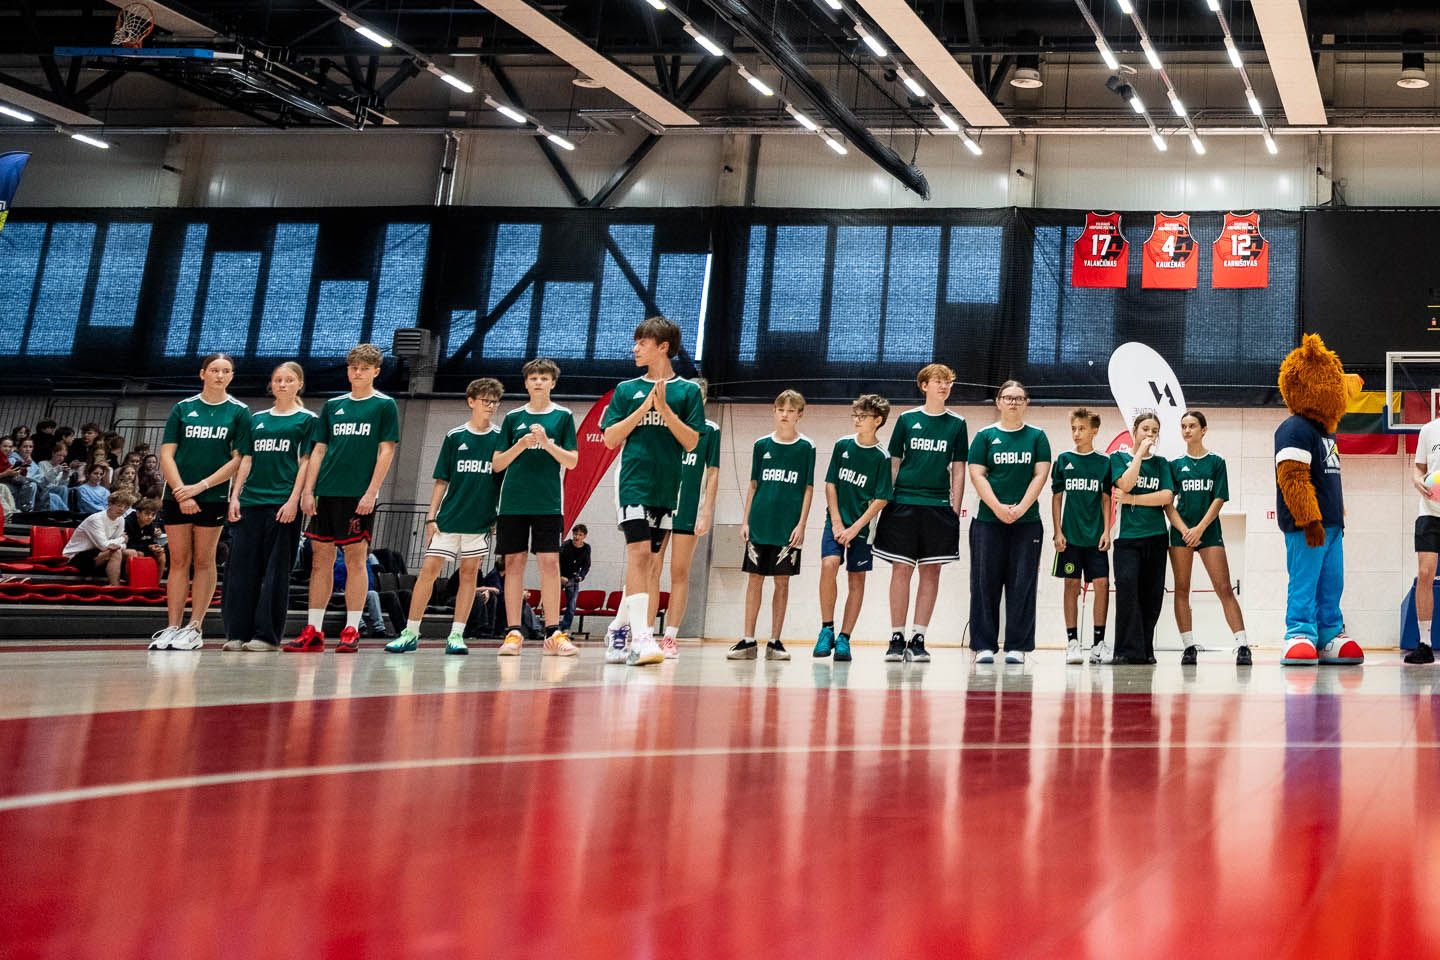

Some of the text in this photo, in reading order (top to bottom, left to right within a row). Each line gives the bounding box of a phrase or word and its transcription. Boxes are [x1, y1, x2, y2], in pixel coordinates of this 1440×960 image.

[1091, 234, 1111, 256] 17
[1161, 235, 1175, 257] 4
[1230, 234, 1251, 256] 12
[185, 425, 228, 439] GABIJA
[333, 423, 371, 436] GABIJA
[254, 438, 291, 452] GABIJA
[910, 437, 947, 453] GABIJA
[993, 451, 1032, 464] GABIJA
[762, 468, 799, 484] GABIJA
[1065, 478, 1099, 492] GABIJA
